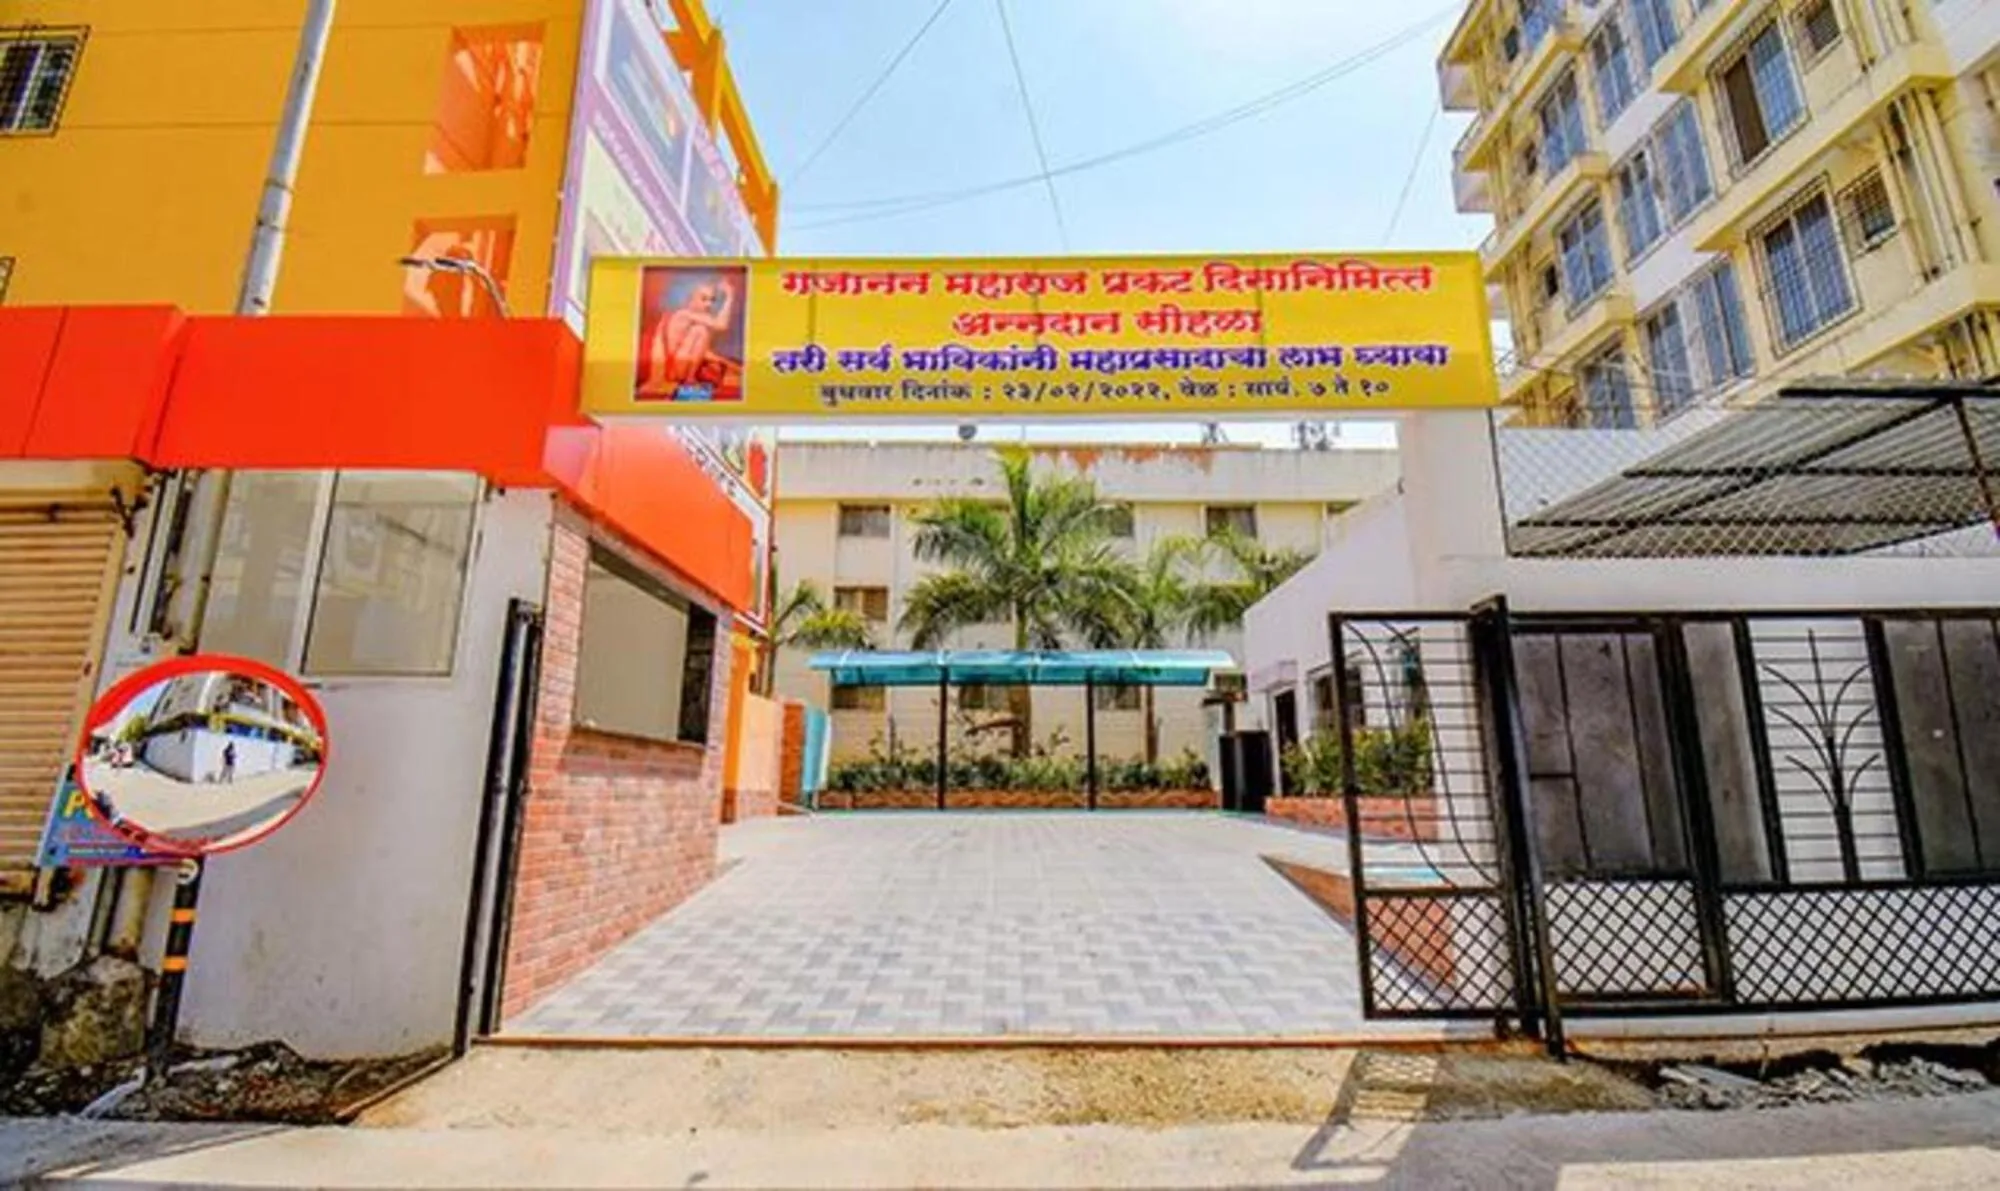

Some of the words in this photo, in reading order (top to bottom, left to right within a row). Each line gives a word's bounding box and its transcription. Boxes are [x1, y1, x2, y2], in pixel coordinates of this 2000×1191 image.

[782, 271, 932, 296] गजानन
[944, 270, 1088, 299] महाराज
[1102, 270, 1193, 295] प्रकट
[951, 311, 1121, 336] अन्नदान
[772, 344, 827, 374] तरी
[837, 343, 893, 372] सर्व
[900, 343, 1059, 373] भाविकांनी
[1068, 346, 1268, 375] महाप्रसादाचा
[1278, 346, 1345, 369] लाभ
[820, 382, 894, 408] बुधवार
[901, 378, 972, 401] दिनांक
[1307, 380, 1327, 397] ७
[1333, 373, 1350, 396] ते
